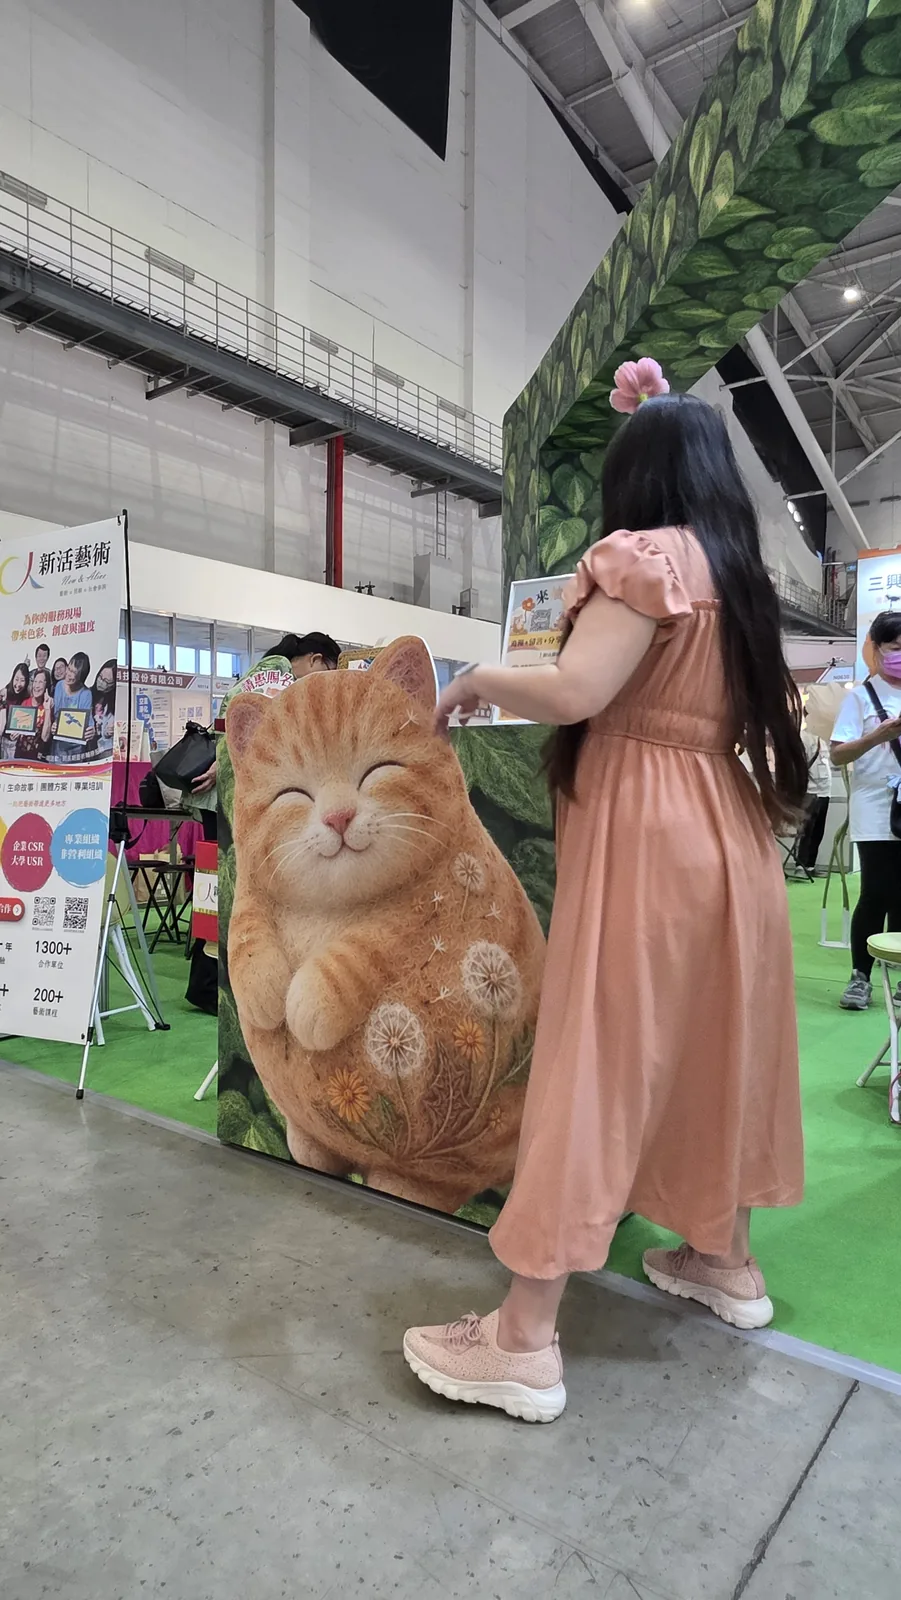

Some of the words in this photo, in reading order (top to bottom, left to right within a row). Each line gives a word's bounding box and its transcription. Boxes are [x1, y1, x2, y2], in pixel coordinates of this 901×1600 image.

[39, 541, 111, 575] 新活藝術
[23, 607, 82, 626] 為你的服務現場
[241, 669, 294, 692] 請惠賜名
[7, 783, 34, 793] 生命故事
[40, 782, 68, 792] 團體方案
[74, 781, 103, 792] 專業培訓
[65, 833, 100, 845] 專業組織
[13, 841, 27, 852] 企業
[27, 841, 45, 852] CSR
[61, 848, 103, 860] 非營利組織
[11, 855, 26, 866] 大學
[26, 855, 44, 866] USR
[35, 940, 72, 955] 1300+
[38, 960, 64, 969] 合作單位
[33, 987, 64, 1003] 200+
[32, 1006, 58, 1018] 藝術課程
